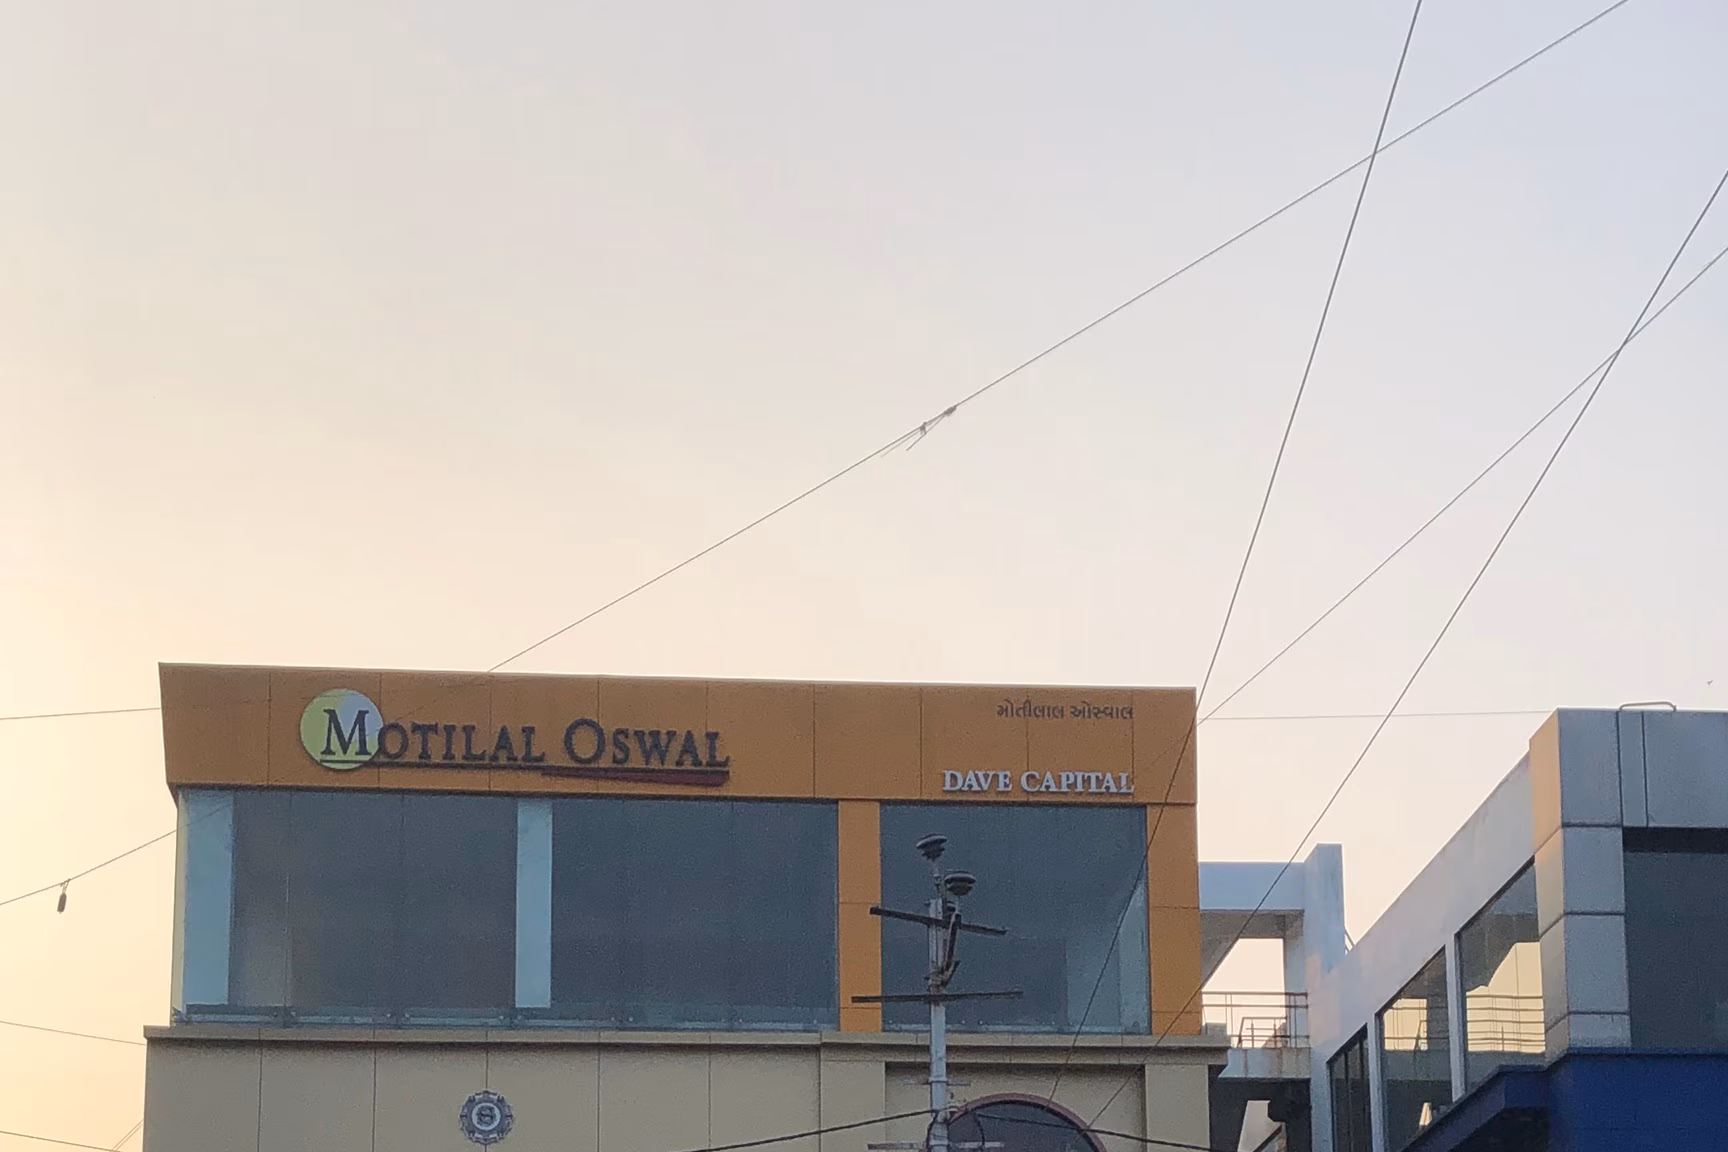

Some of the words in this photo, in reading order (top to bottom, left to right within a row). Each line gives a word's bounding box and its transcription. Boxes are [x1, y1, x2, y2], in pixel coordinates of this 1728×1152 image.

[322, 708, 545, 762] MOTILAL
[563, 717, 730, 768] OSWAL
[943, 769, 1012, 793] DAVE
[1020, 770, 1135, 795] CAPITAL
